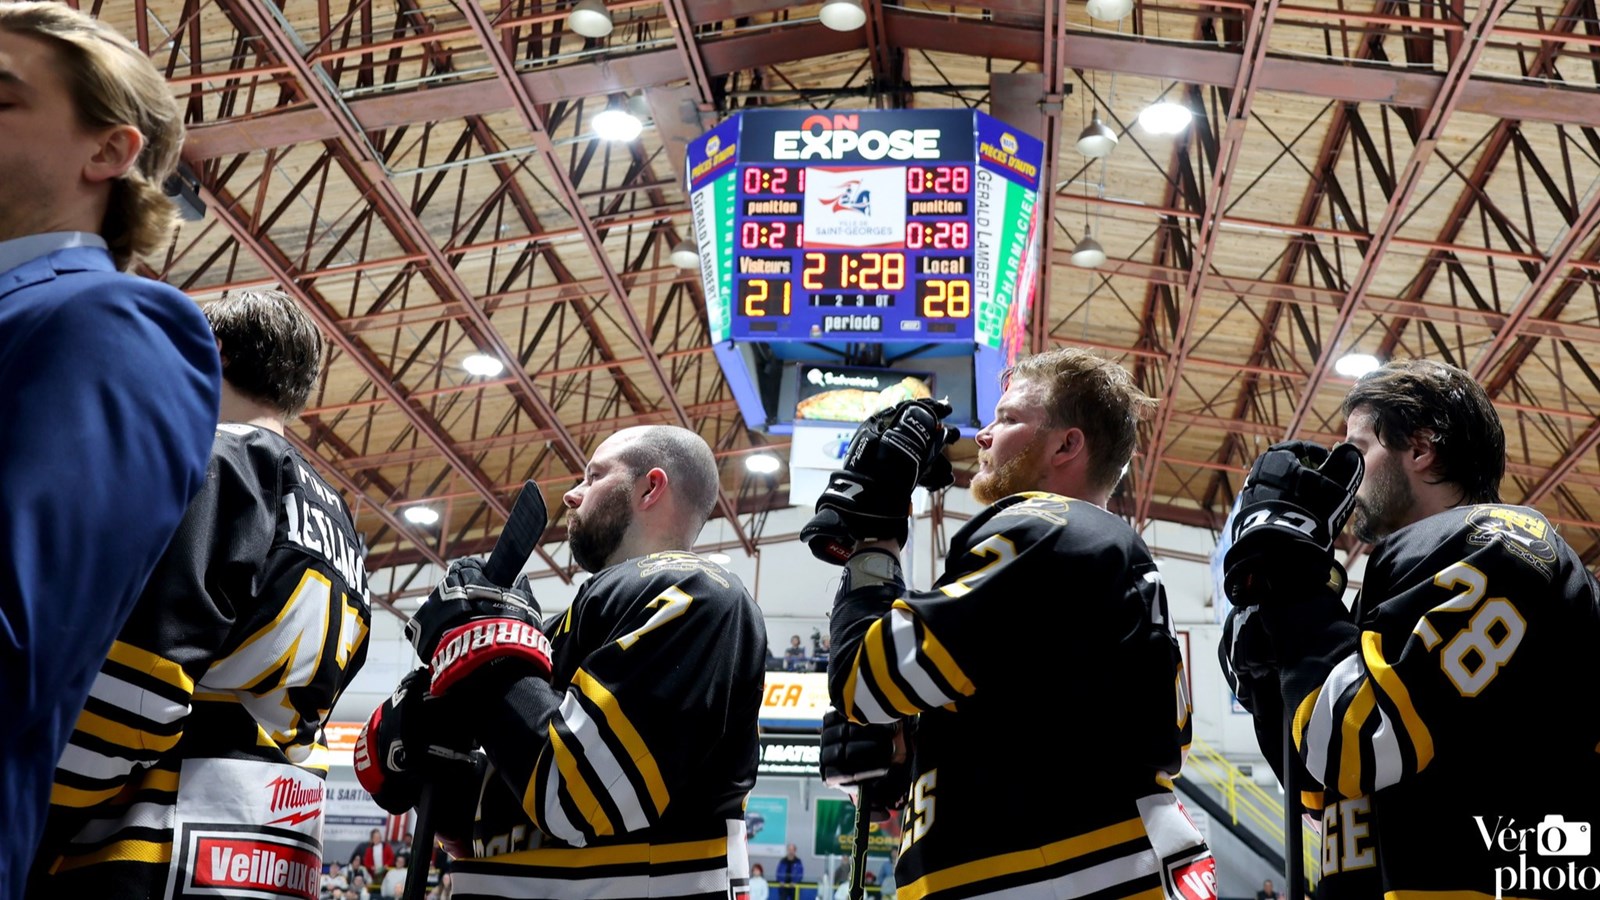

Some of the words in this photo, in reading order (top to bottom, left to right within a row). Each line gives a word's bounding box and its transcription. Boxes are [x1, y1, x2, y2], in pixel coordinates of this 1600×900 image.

[801, 114, 860, 131] ON
[773, 129, 941, 160] EXPOSE
[907, 167, 970, 194] 0:28
[747, 201, 798, 217] punition
[912, 200, 963, 216] punition
[977, 169, 993, 227] GÉRALD
[815, 226, 893, 236] SAINT-GEORGES
[906, 222, 970, 249] 0:28
[996, 188, 1037, 309] PHARMACIEN
[739, 256, 791, 274] Visiteurs
[922, 257, 965, 274] Local
[975, 230, 992, 299] LAMBERT
[923, 280, 970, 318] 28
[617, 584, 694, 652] 7
[1411, 561, 1528, 698] 28
[210, 846, 307, 892] Veilleux
